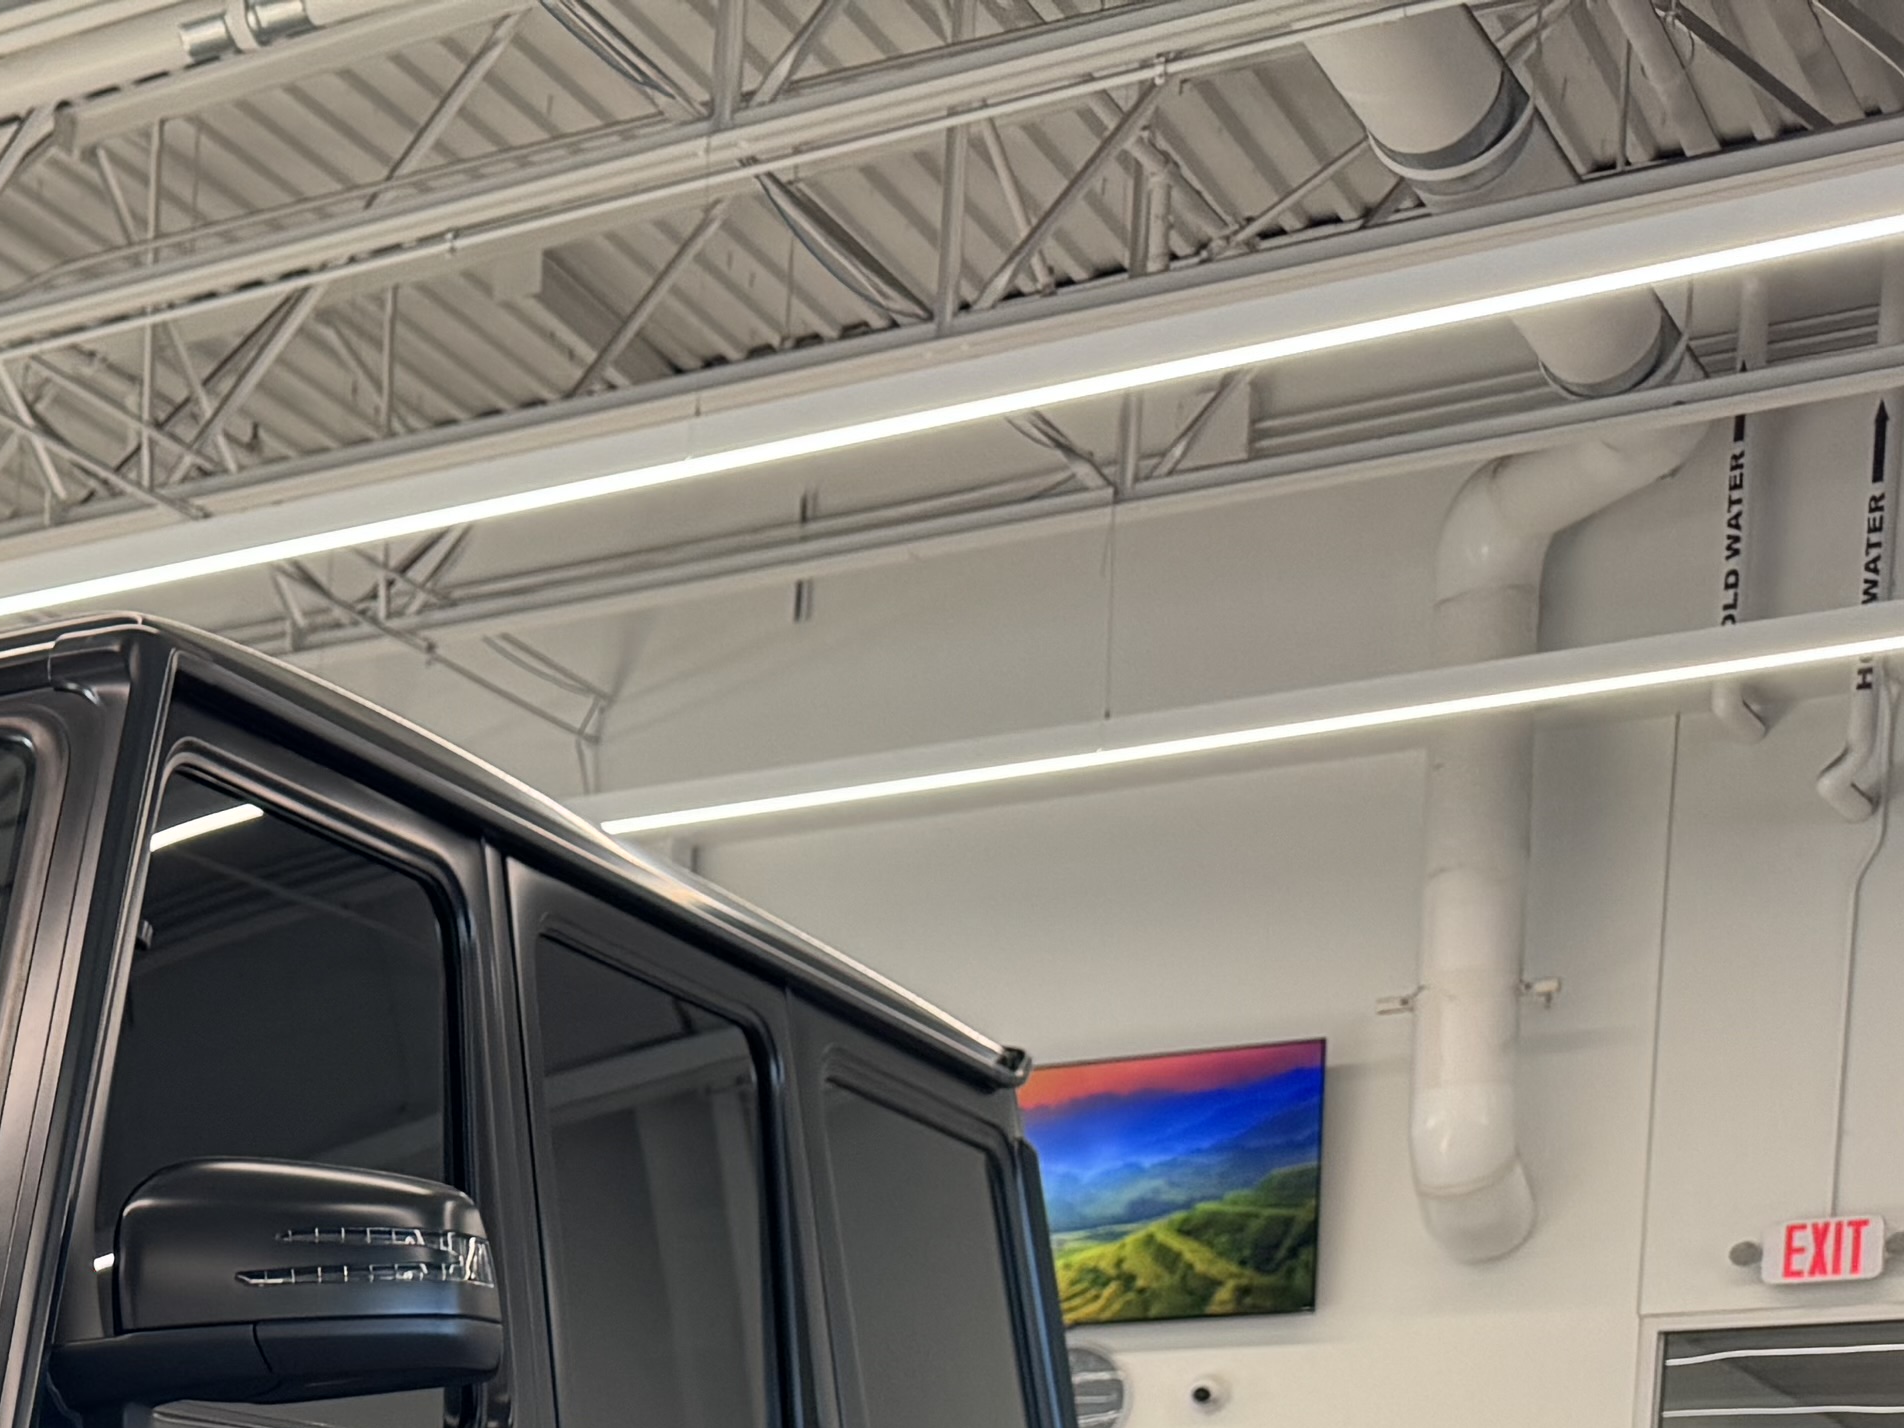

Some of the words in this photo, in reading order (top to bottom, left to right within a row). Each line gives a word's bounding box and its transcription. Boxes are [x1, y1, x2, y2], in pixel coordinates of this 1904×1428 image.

[1725, 450, 1745, 560] WATER
[1861, 491, 1885, 604] WATER
[1721, 568, 1739, 626] OLD
[1782, 1219, 1869, 1278] EXIT
